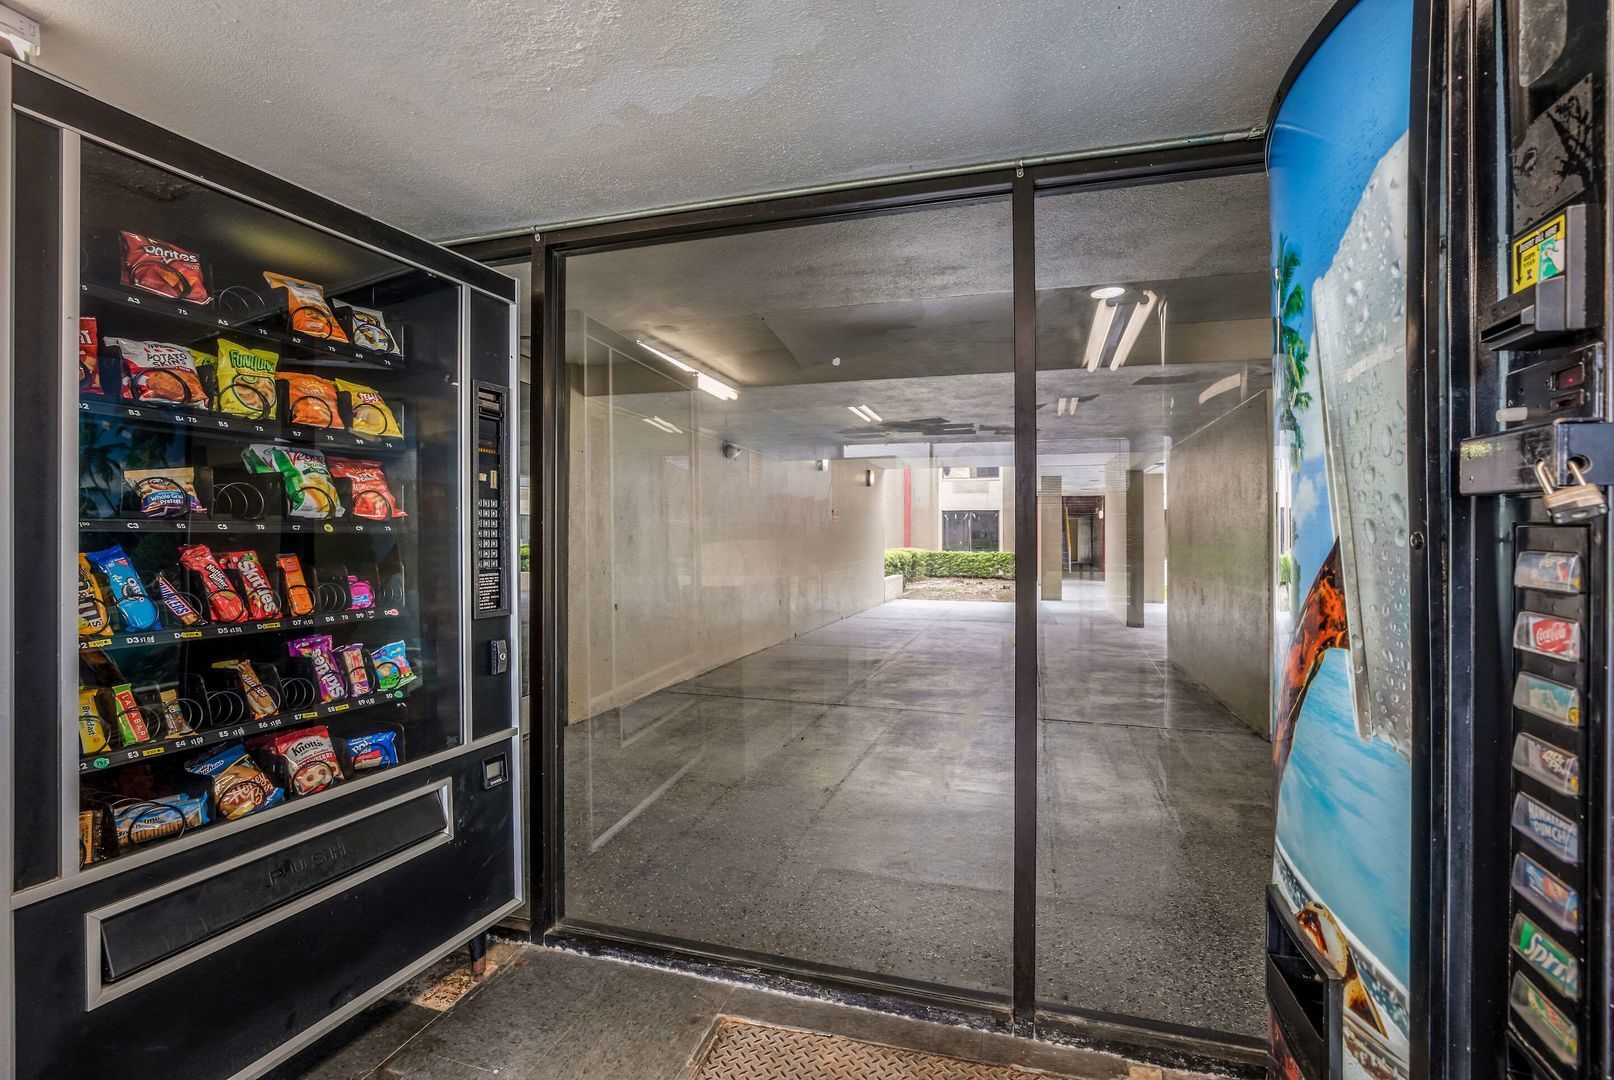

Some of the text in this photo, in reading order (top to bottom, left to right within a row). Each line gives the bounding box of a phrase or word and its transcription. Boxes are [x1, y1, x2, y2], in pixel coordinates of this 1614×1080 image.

[144, 245, 198, 263] Doritos
[127, 296, 141, 305] A3
[177, 308, 188, 316] 75
[217, 319, 229, 327] A5
[258, 328, 268, 336] 75
[147, 353, 188, 362] POTATO
[152, 358, 188, 368] SKINS
[128, 409, 141, 417] B3
[218, 420, 229, 428] B5
[237, 560, 276, 613] Skittles
[126, 636, 140, 644] D3
[121, 694, 146, 736] LAABAR
[327, 705, 336, 713] E8
[258, 721, 268, 729] E6
[218, 730, 229, 738] E5
[127, 751, 140, 759] E3
[291, 739, 324, 757] Knott's
[265, 842, 348, 884] PUSH
